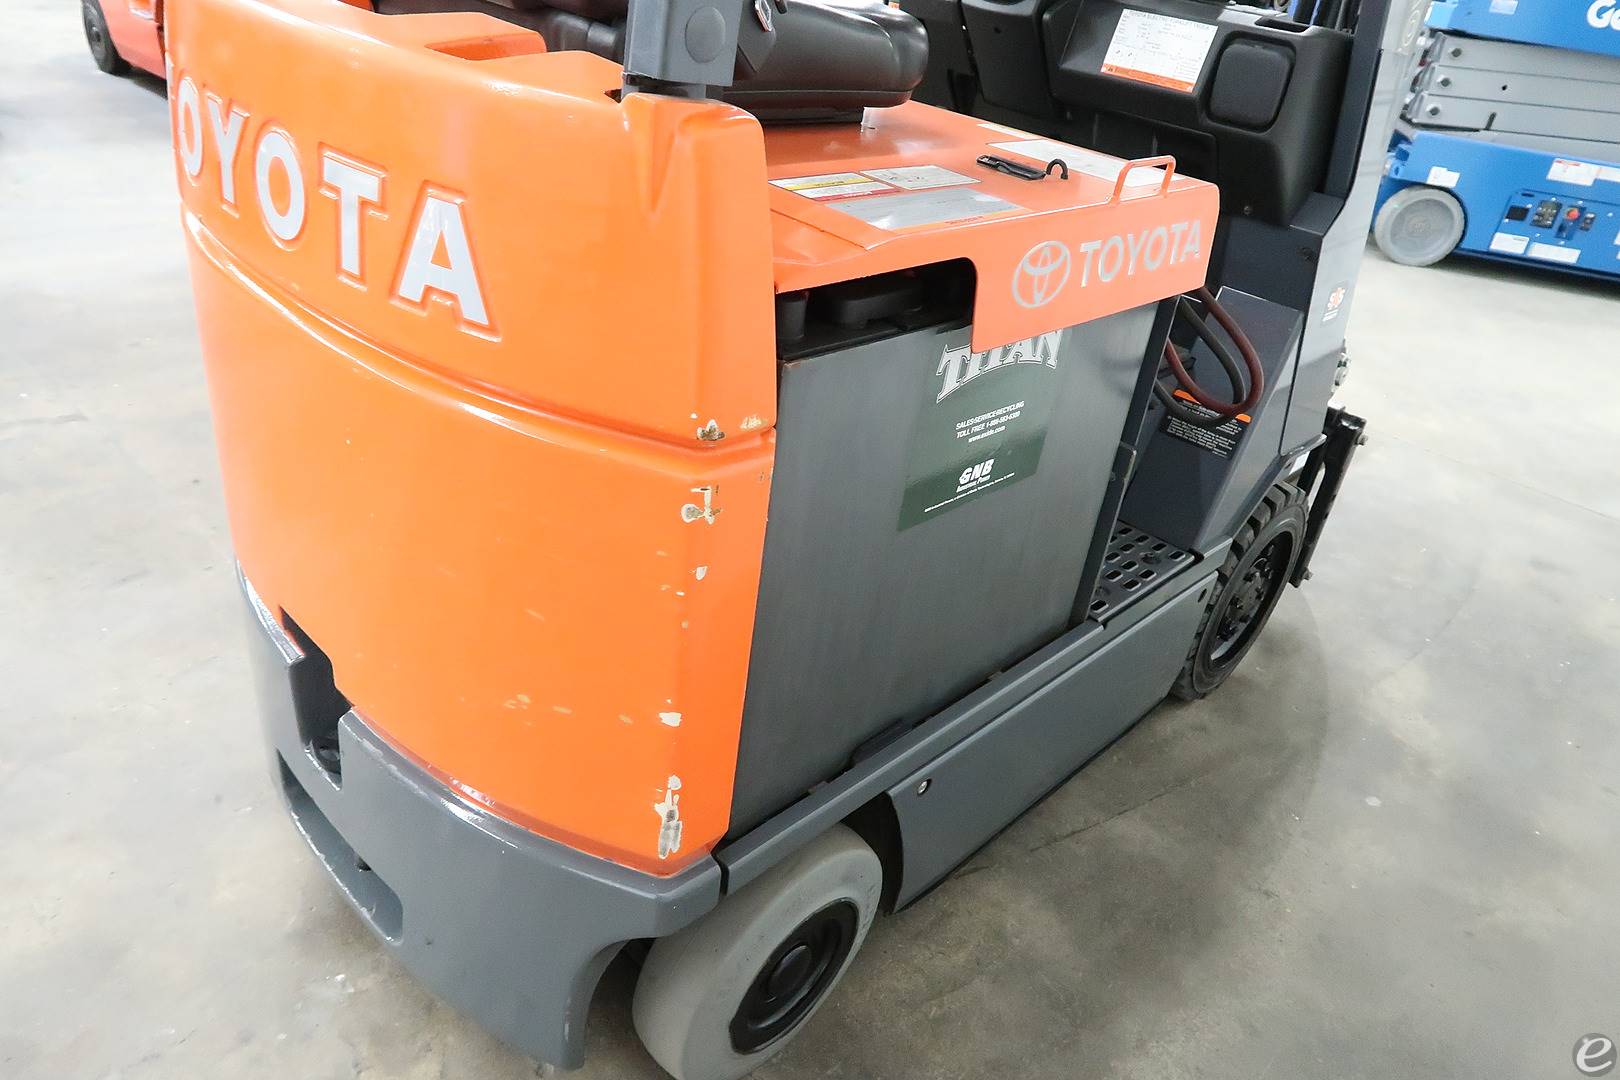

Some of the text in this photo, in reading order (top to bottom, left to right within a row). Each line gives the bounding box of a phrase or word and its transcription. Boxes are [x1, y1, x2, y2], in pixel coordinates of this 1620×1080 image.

[165, 53, 492, 327] OYOTA
[1080, 219, 1201, 288] TOYOTA
[956, 428, 971, 439] TOLL
[971, 422, 986, 434] FREE
[959, 458, 995, 485] GNB
